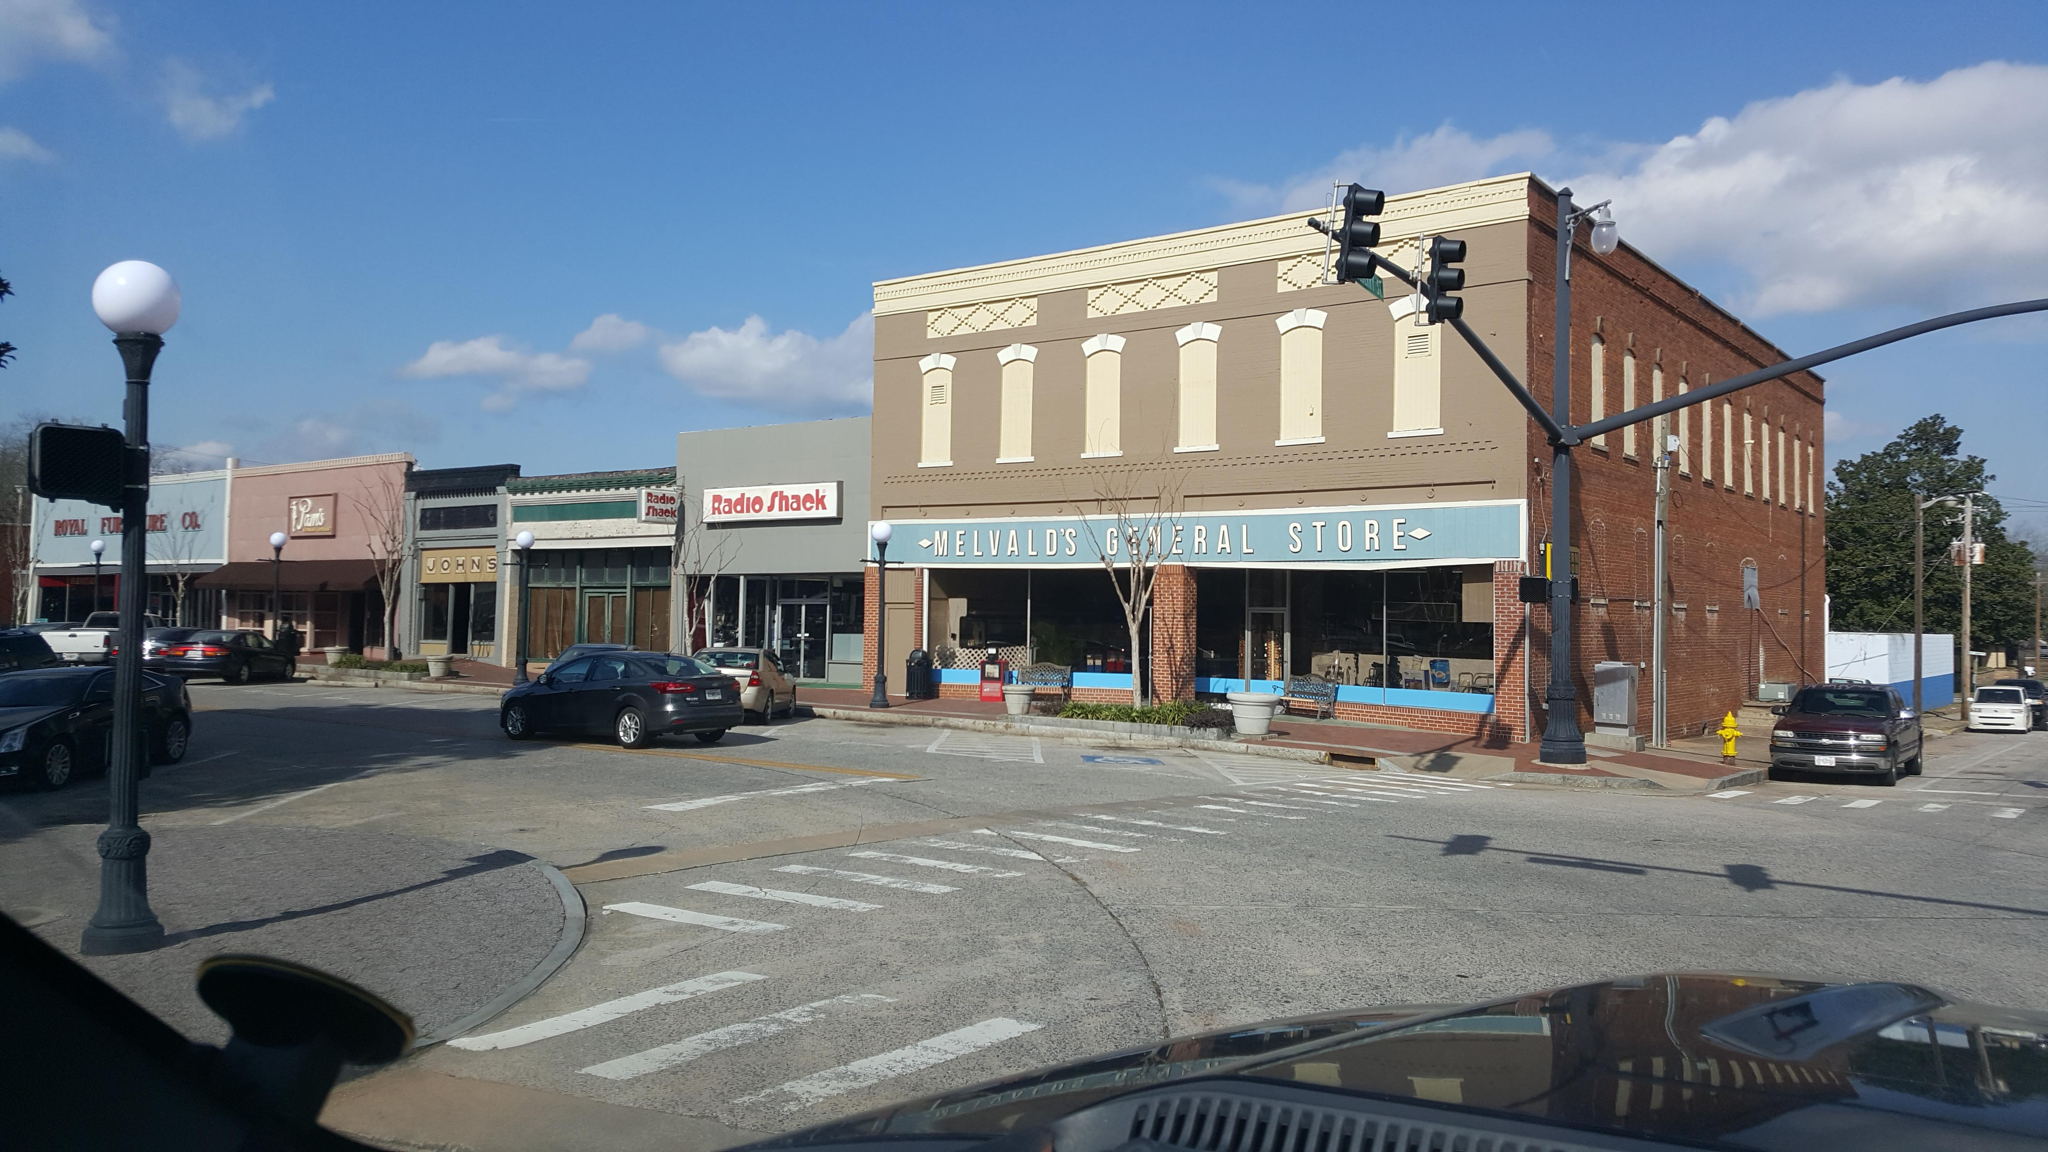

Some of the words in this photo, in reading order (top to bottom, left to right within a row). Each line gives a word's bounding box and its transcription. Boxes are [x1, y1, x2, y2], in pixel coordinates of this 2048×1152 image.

[646, 492, 676, 505] Radio
[711, 493, 764, 515] Radio
[767, 489, 827, 512] Shack
[645, 506, 678, 518] Shack
[54, 519, 87, 536] ROYAL
[101, 514, 168, 535] FURURE
[181, 511, 201, 531] CO.
[934, 527, 1078, 557] MELVALD'S
[1106, 523, 1255, 556] GENERAL
[1288, 518, 1408, 554] STORE
[426, 556, 497, 573] JOHNS
